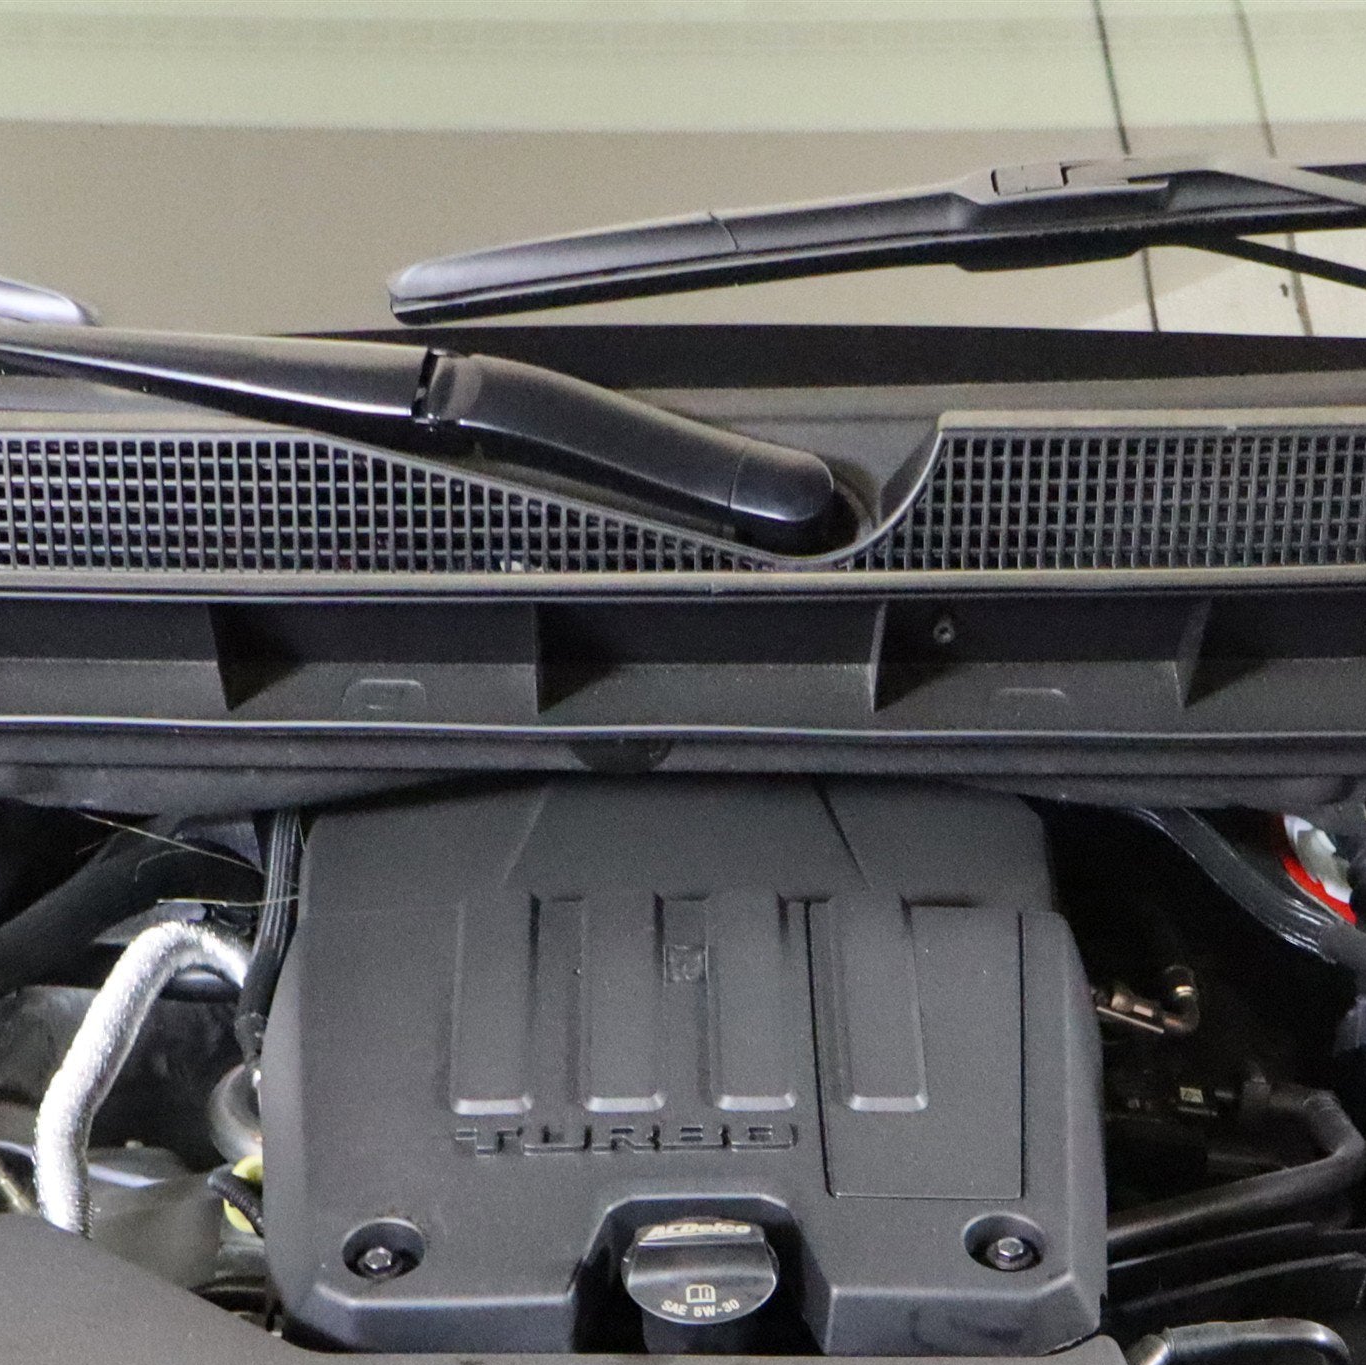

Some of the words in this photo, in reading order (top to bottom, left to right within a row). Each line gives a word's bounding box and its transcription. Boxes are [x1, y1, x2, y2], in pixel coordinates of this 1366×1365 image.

[455, 1124, 799, 1157] TURBO
[640, 1222, 752, 1242] ACDelco
[661, 1300, 689, 1316] SAE
[693, 1299, 740, 1318] 5W-30
